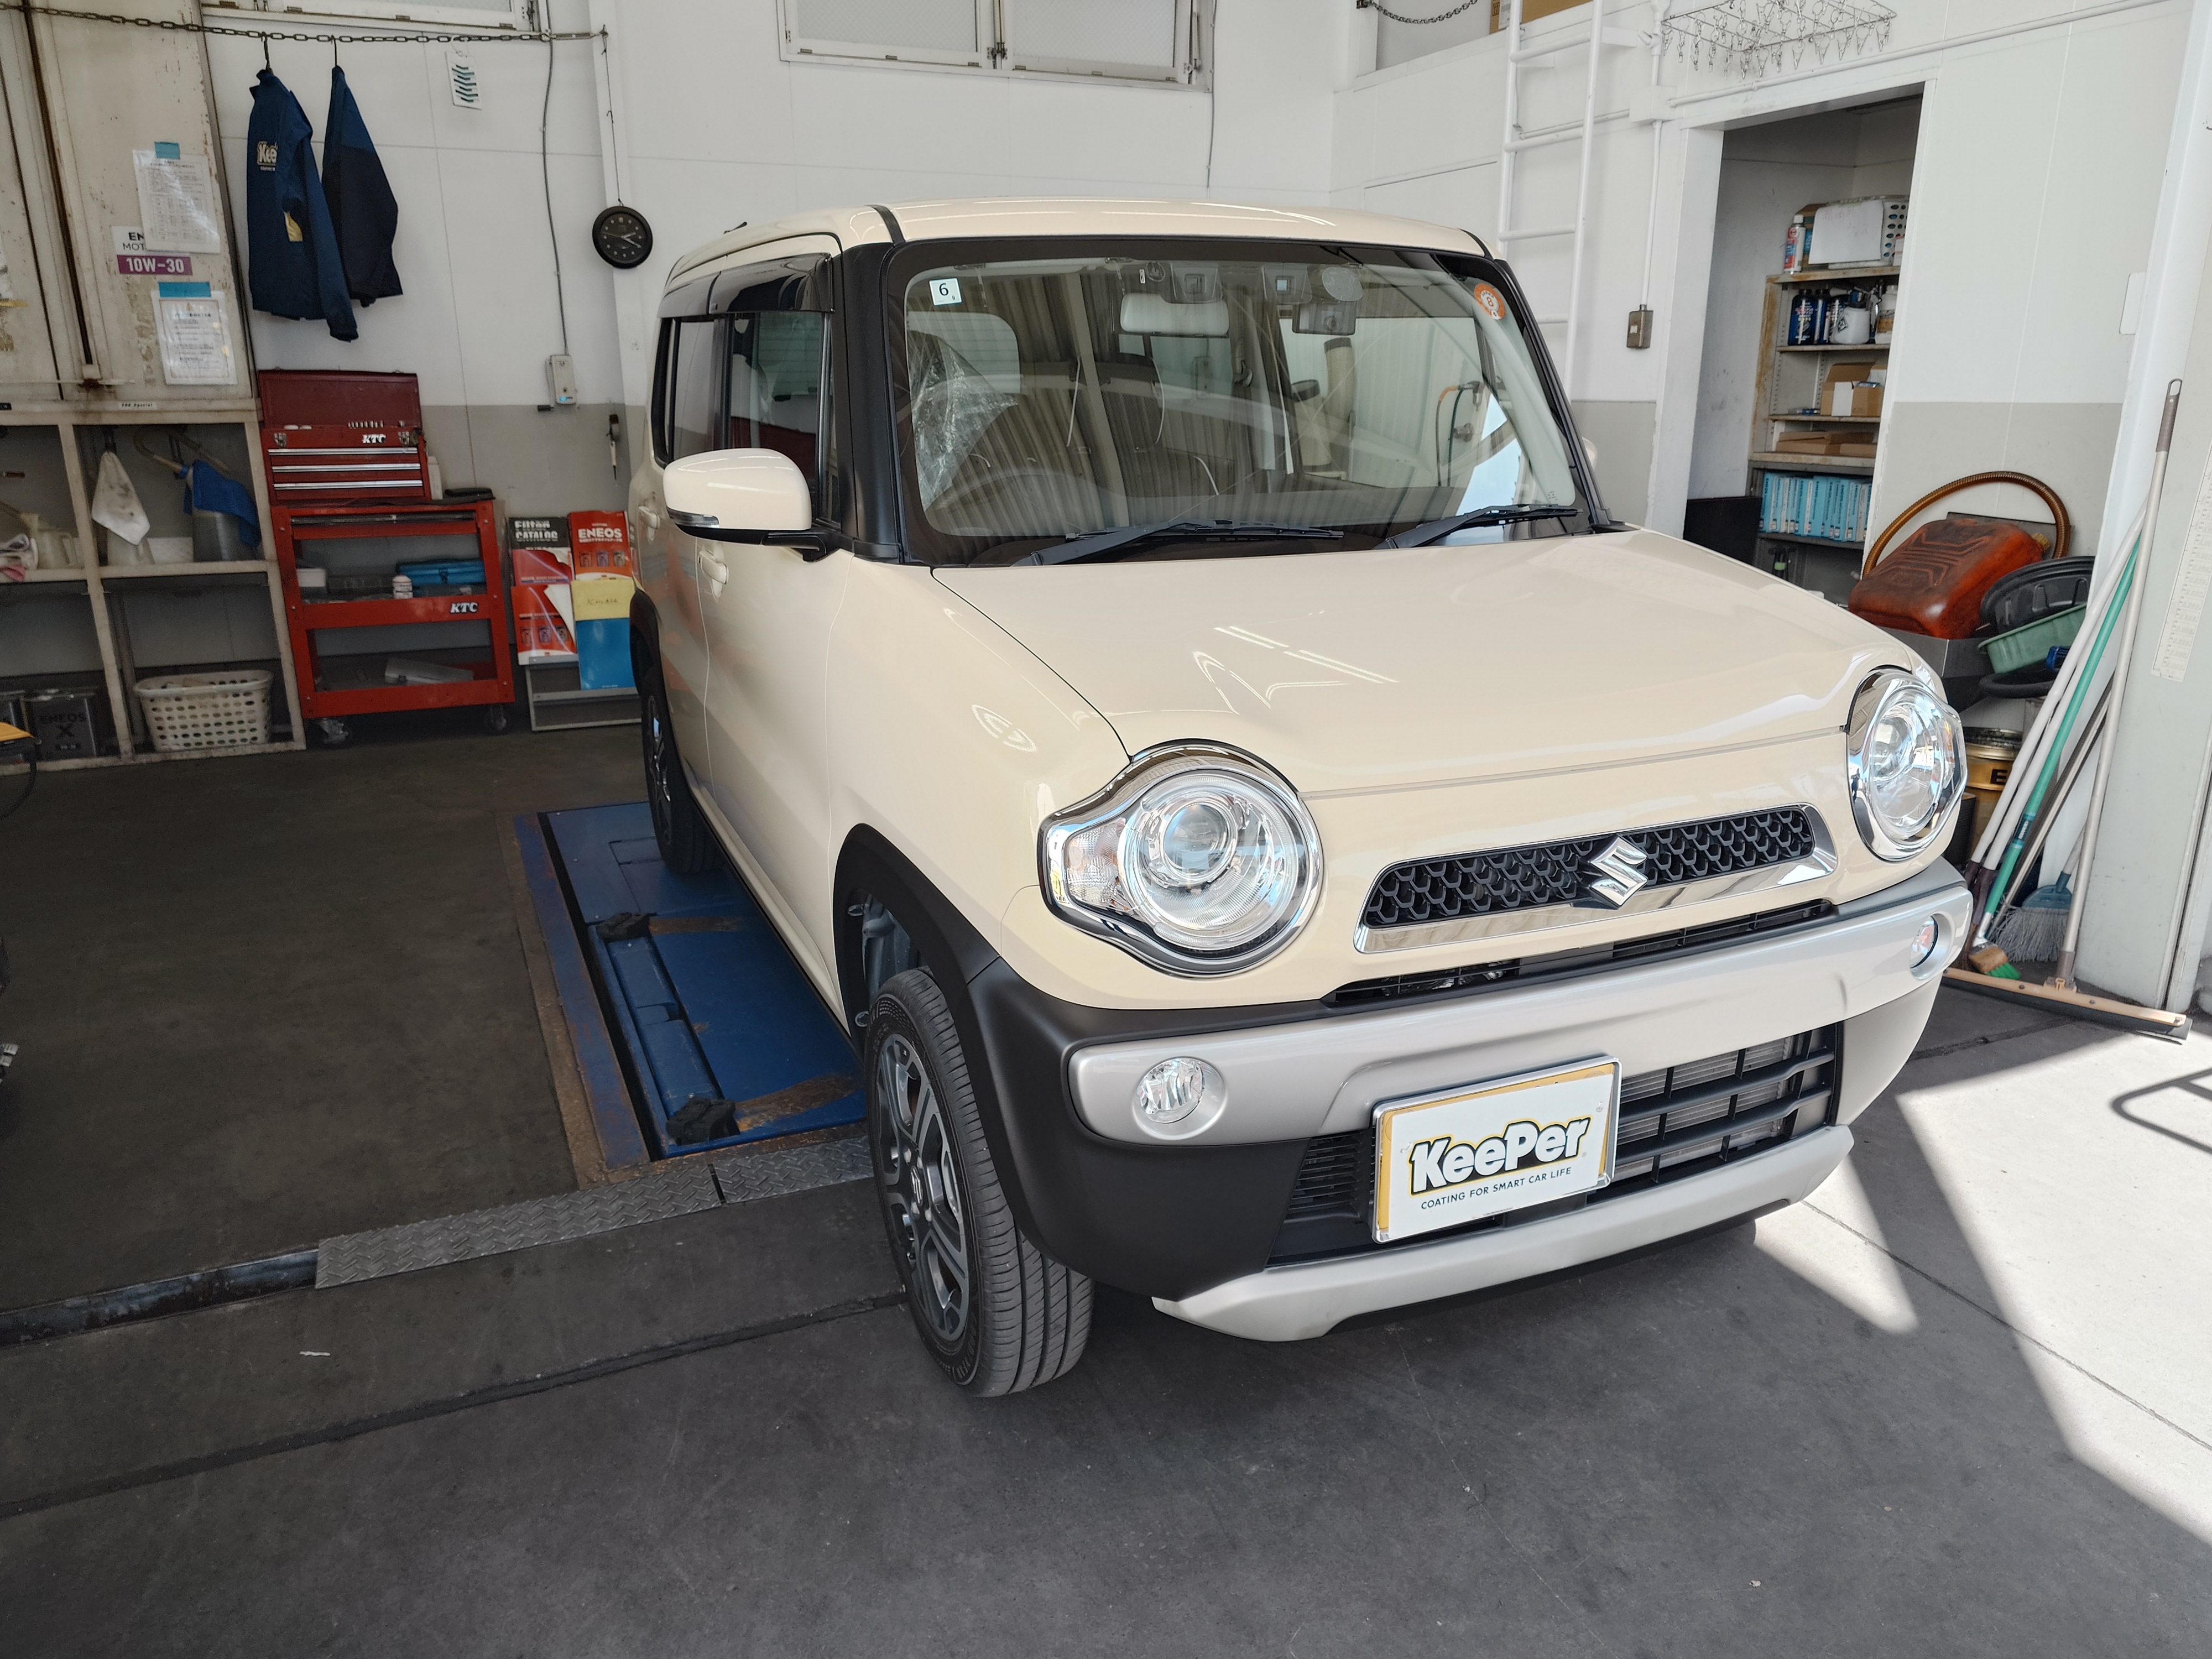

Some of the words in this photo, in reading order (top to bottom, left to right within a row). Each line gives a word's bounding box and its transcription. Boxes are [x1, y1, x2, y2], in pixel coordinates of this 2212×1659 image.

[126, 257, 185, 273] 10W-30
[939, 283, 949, 296] 6
[1486, 297, 1494, 307] 8
[362, 434, 386, 444] KTC
[578, 528, 622, 539] ENEOS
[450, 602, 478, 613] KTC
[1410, 1117, 1591, 1194] KeePer
[1421, 1192, 1465, 1209] COATING
[1470, 1186, 1489, 1198] FOR
[1493, 1178, 1526, 1192] SMART
[1528, 1173, 1547, 1183] CAR
[1550, 1167, 1572, 1179] LIFE
